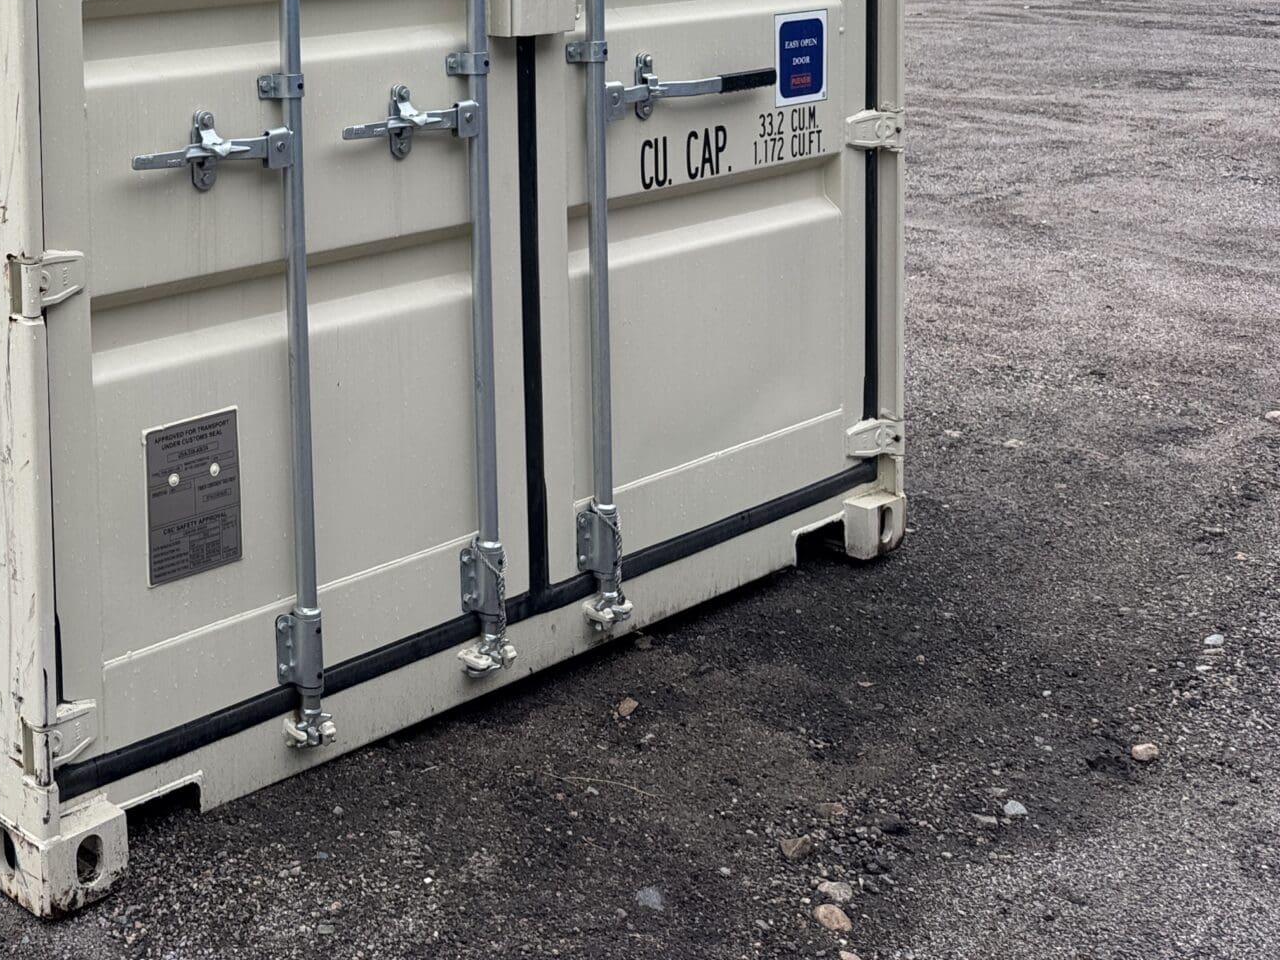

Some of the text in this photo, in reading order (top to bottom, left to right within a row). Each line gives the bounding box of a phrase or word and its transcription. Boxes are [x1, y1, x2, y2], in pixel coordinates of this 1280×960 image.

[800, 37, 818, 47] OPEN
[792, 56, 811, 66] DOOR
[640, 136, 672, 190] CU.
[686, 125, 732, 180] CAP.
[759, 111, 785, 138] 33.2
[790, 129, 826, 158] CU.FT.
